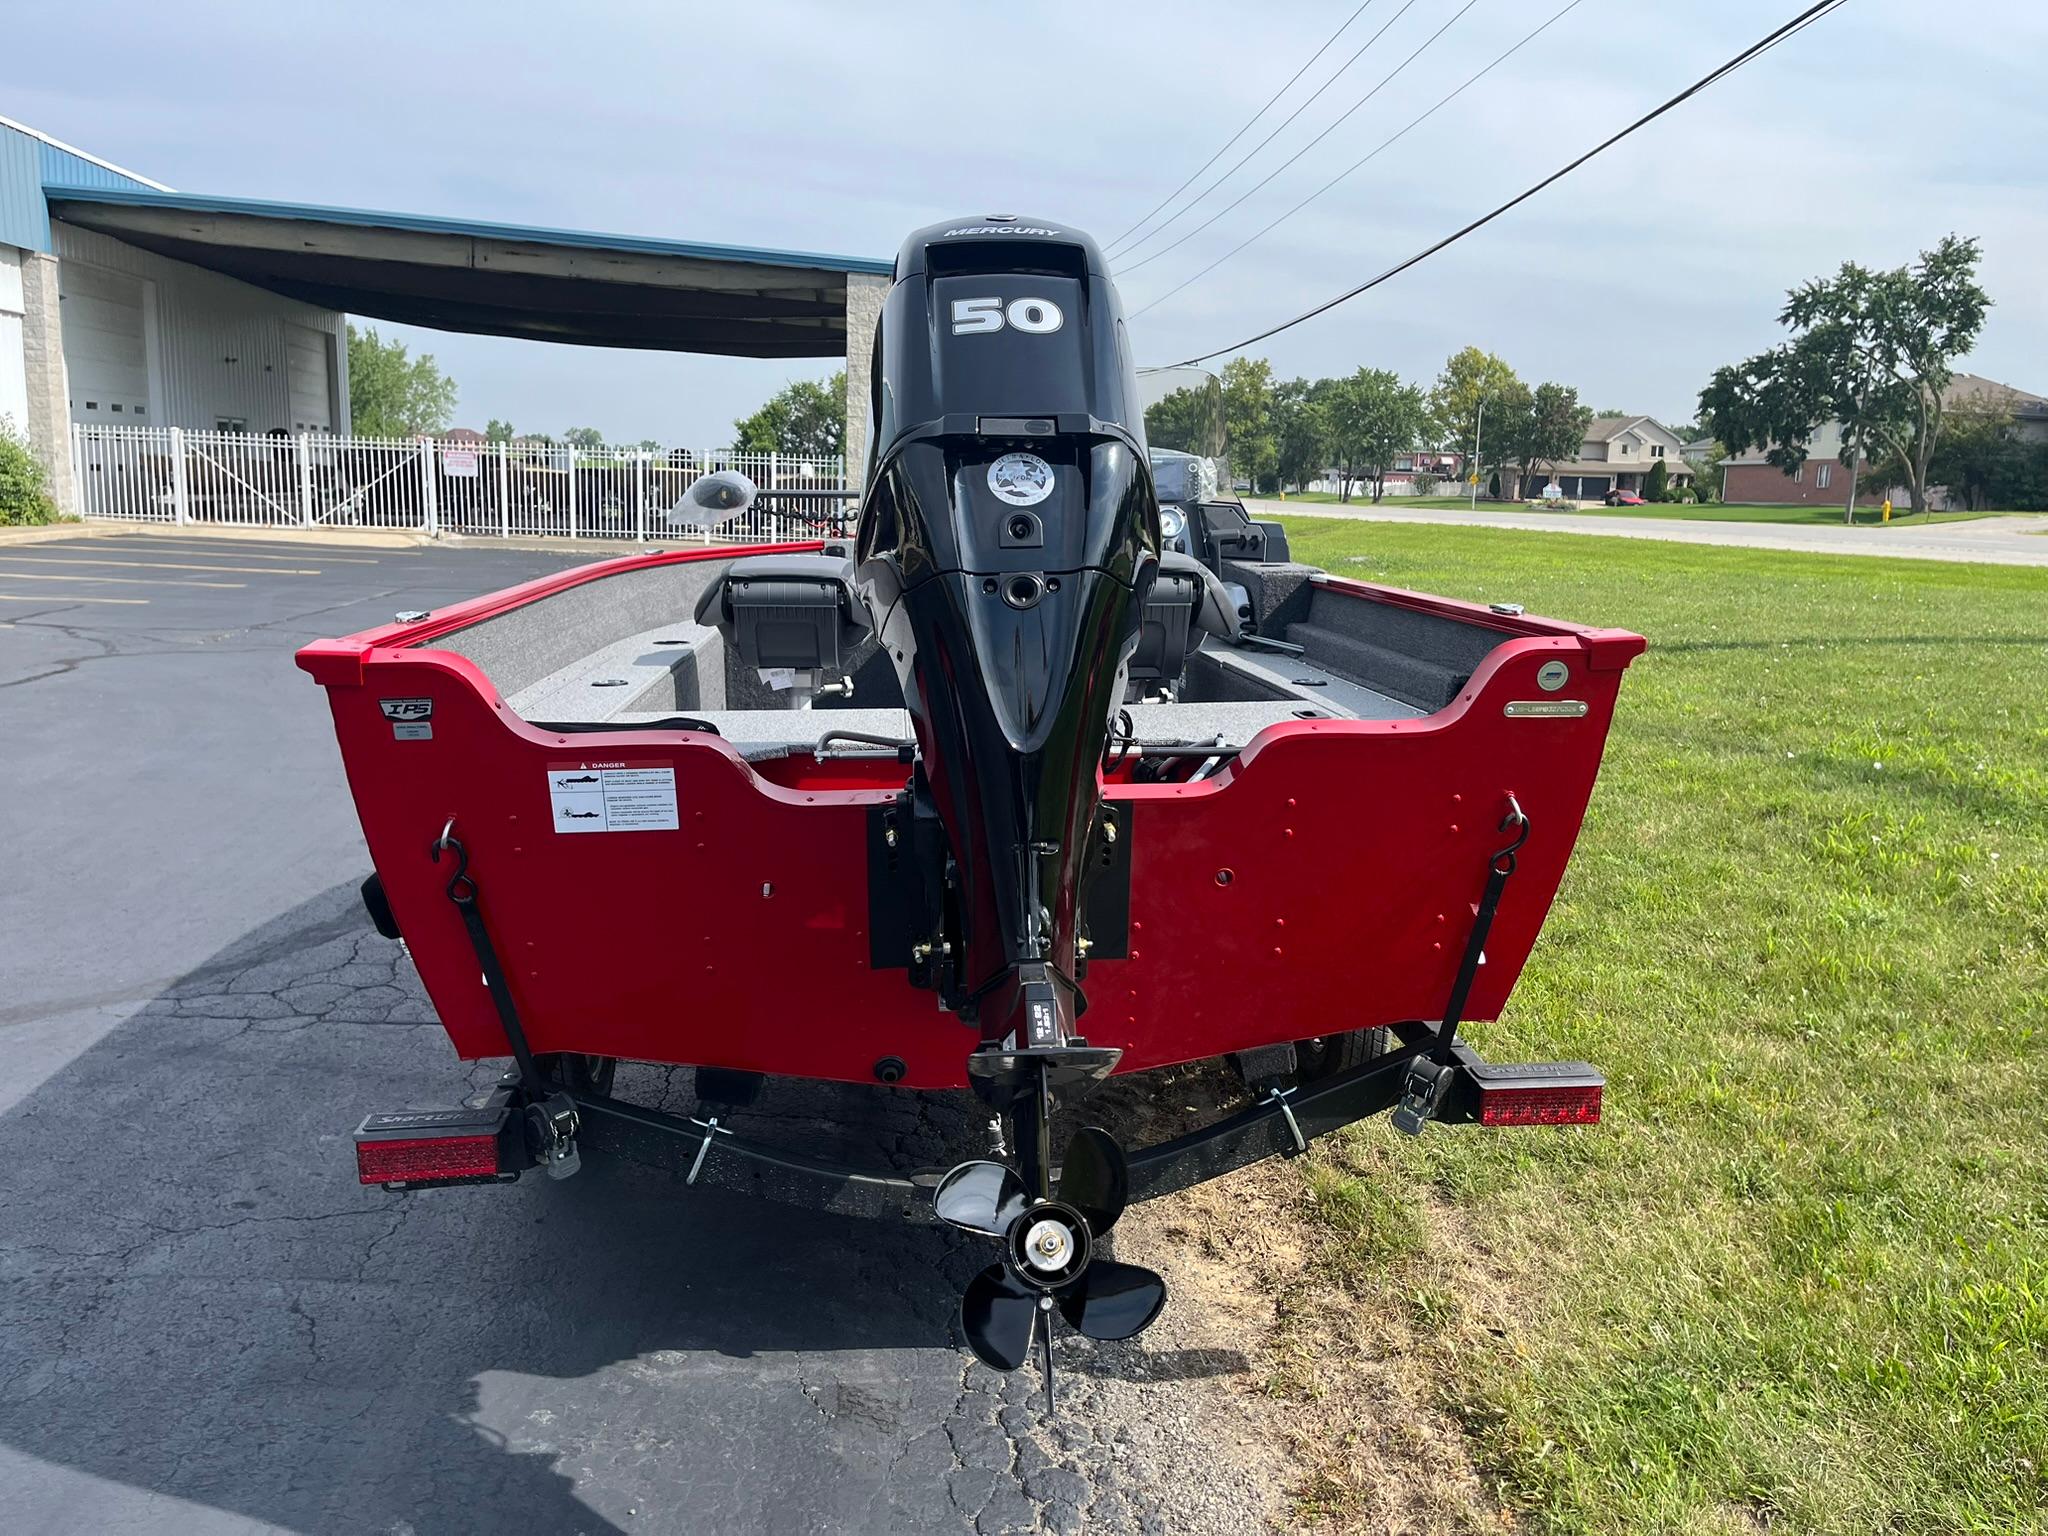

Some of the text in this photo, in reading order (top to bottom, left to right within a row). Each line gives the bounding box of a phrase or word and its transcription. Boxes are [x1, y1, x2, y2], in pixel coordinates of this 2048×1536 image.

[943, 226, 1062, 237] MERCURY
[951, 297, 1064, 336] 50
[388, 704, 429, 715] IPS
